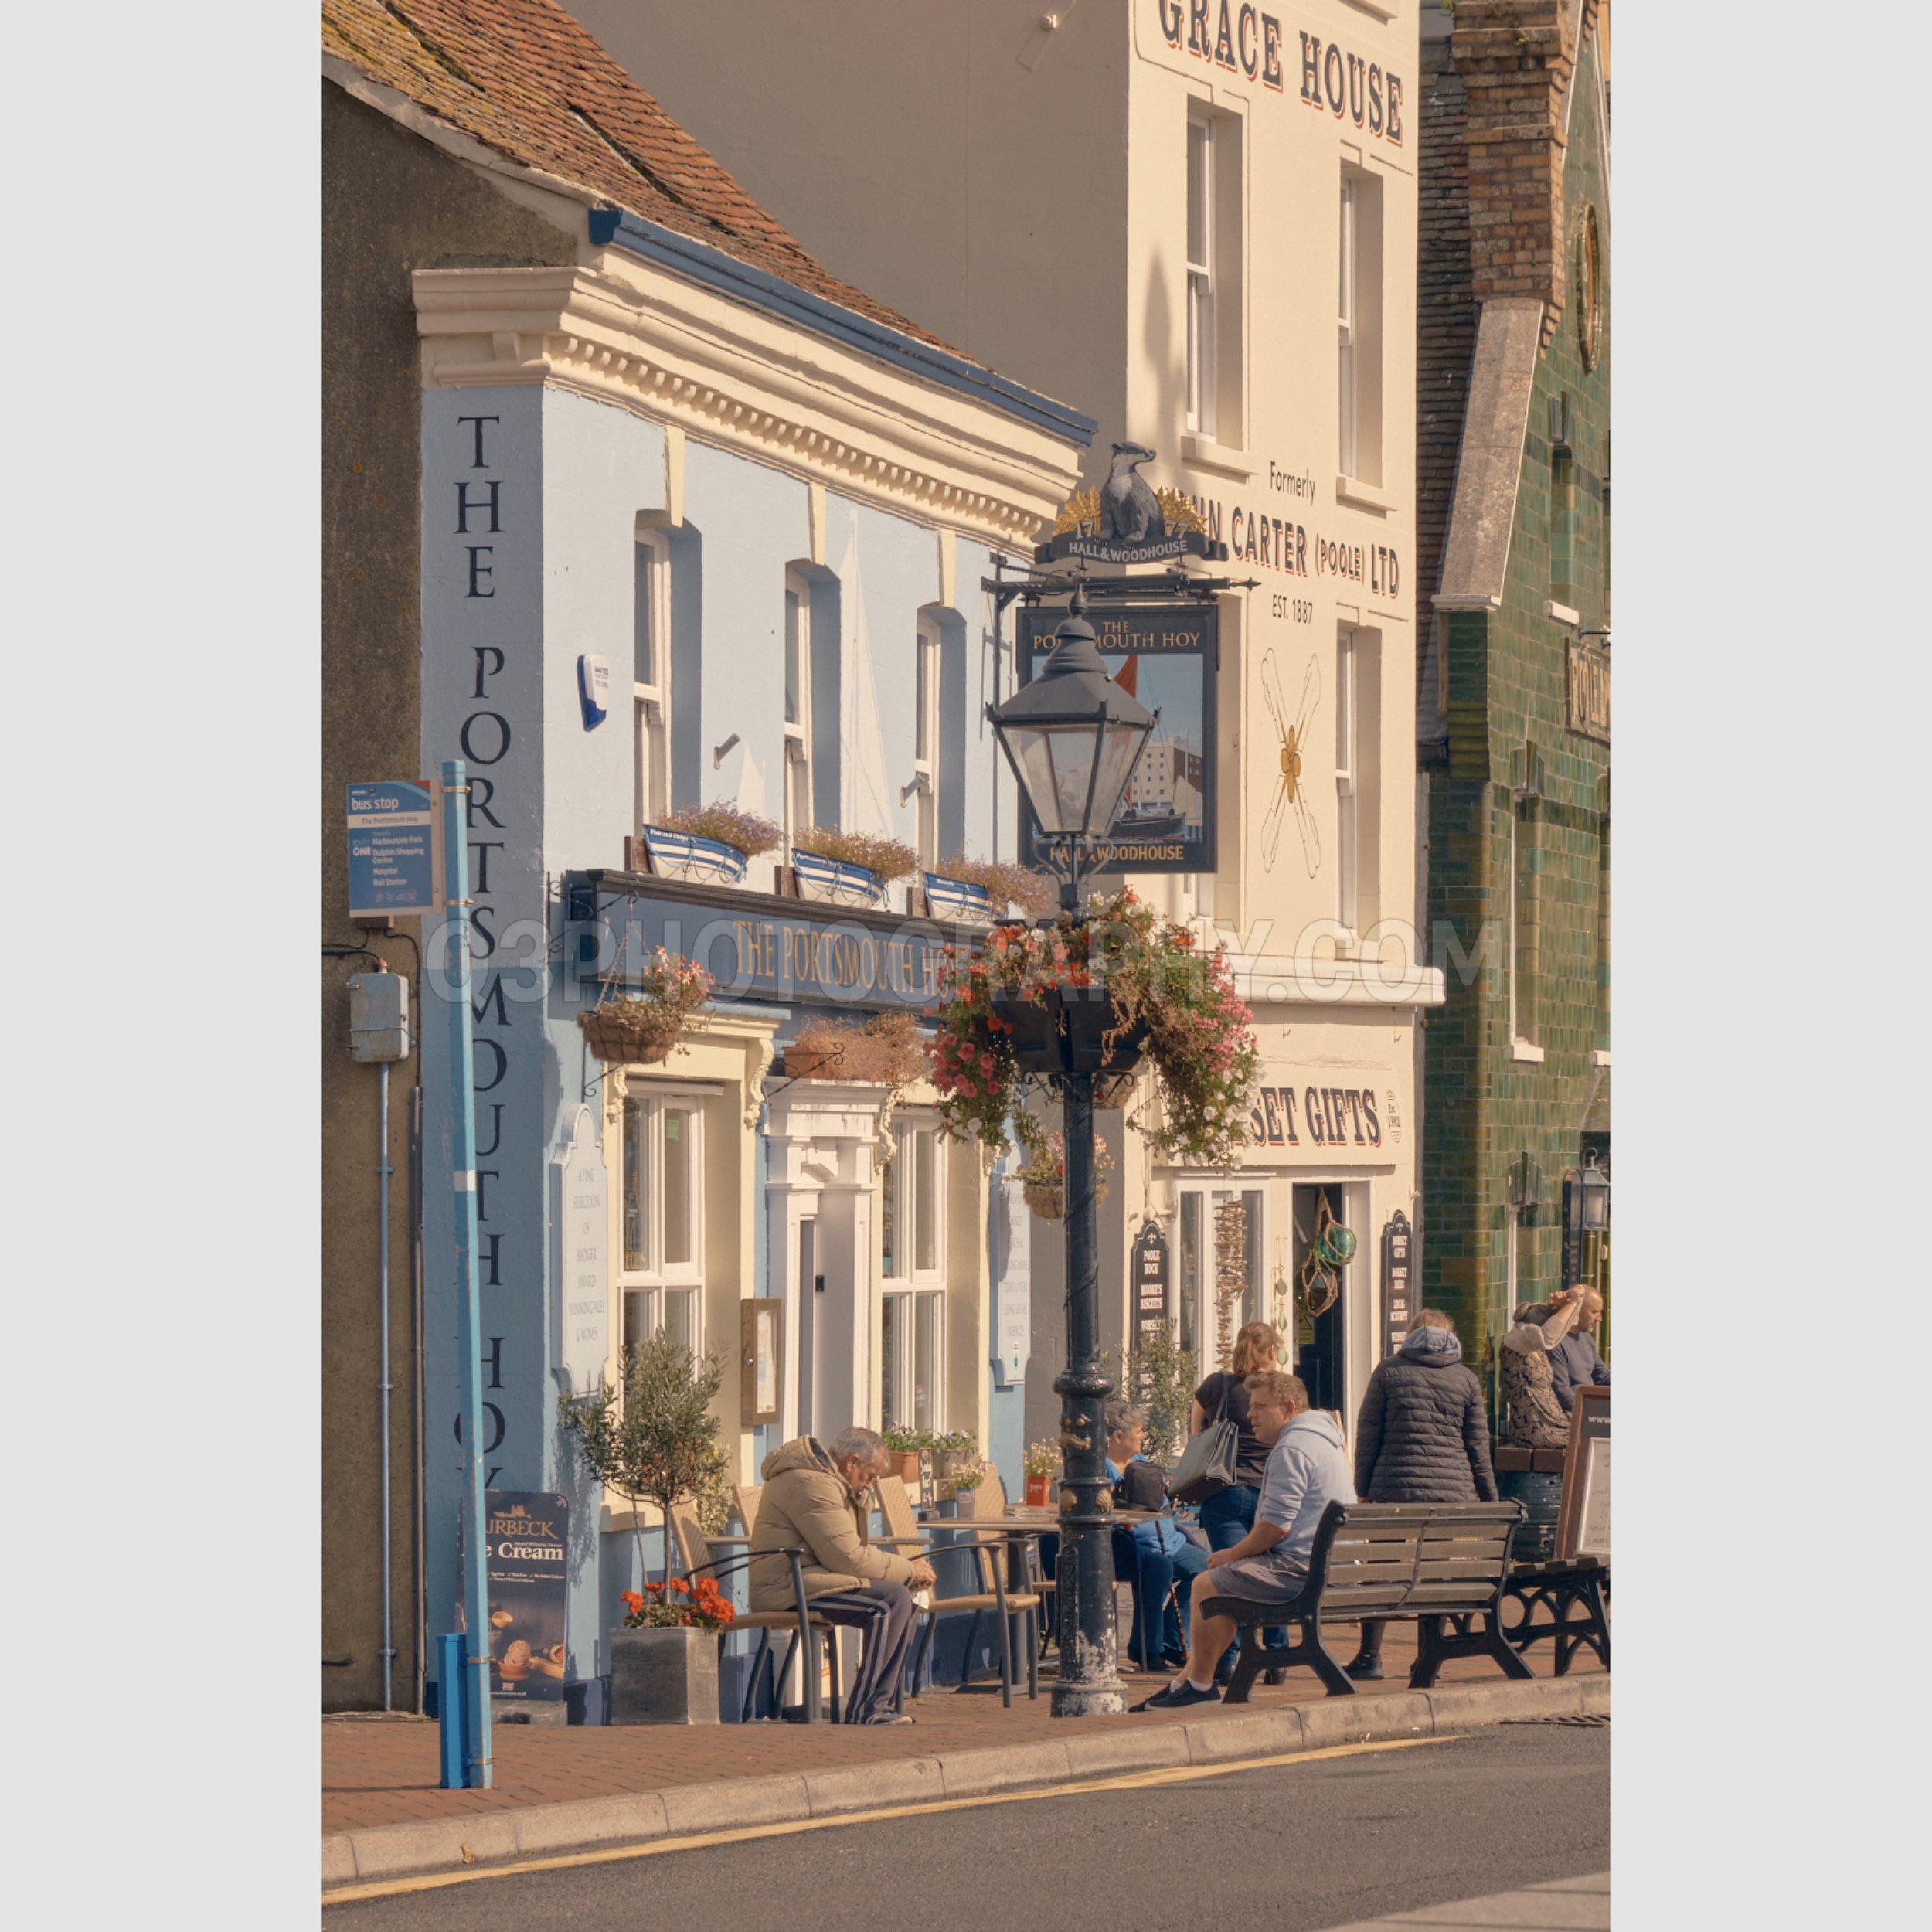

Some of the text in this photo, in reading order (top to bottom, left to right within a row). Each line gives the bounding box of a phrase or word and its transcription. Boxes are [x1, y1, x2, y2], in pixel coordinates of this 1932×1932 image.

[1159, 0, 1403, 148] GRACE HOUSE
[1270, 461, 1315, 506] Formerly
[454, 415, 506, 598] THE
[1075, 519, 1189, 539] 17 77
[1232, 506, 1308, 577] CARTER
[1315, 533, 1366, 583] (POOLE)
[1371, 544, 1400, 599] LTD
[1273, 594, 1313, 624] EST. 1887
[1103, 621, 1129, 633] THE
[1033, 632, 1200, 650] POMOUTH HOY
[352, 798, 399, 811] bus stop
[733, 920, 774, 978] THE
[782, 927, 916, 994] PORTSMOUTH
[1304, 1086, 1381, 1148] GIFTS
[1144, 1250, 1161, 1262] POOLE
[485, 1519, 560, 1540] URBECK
[498, 1542, 564, 1561] Cream
